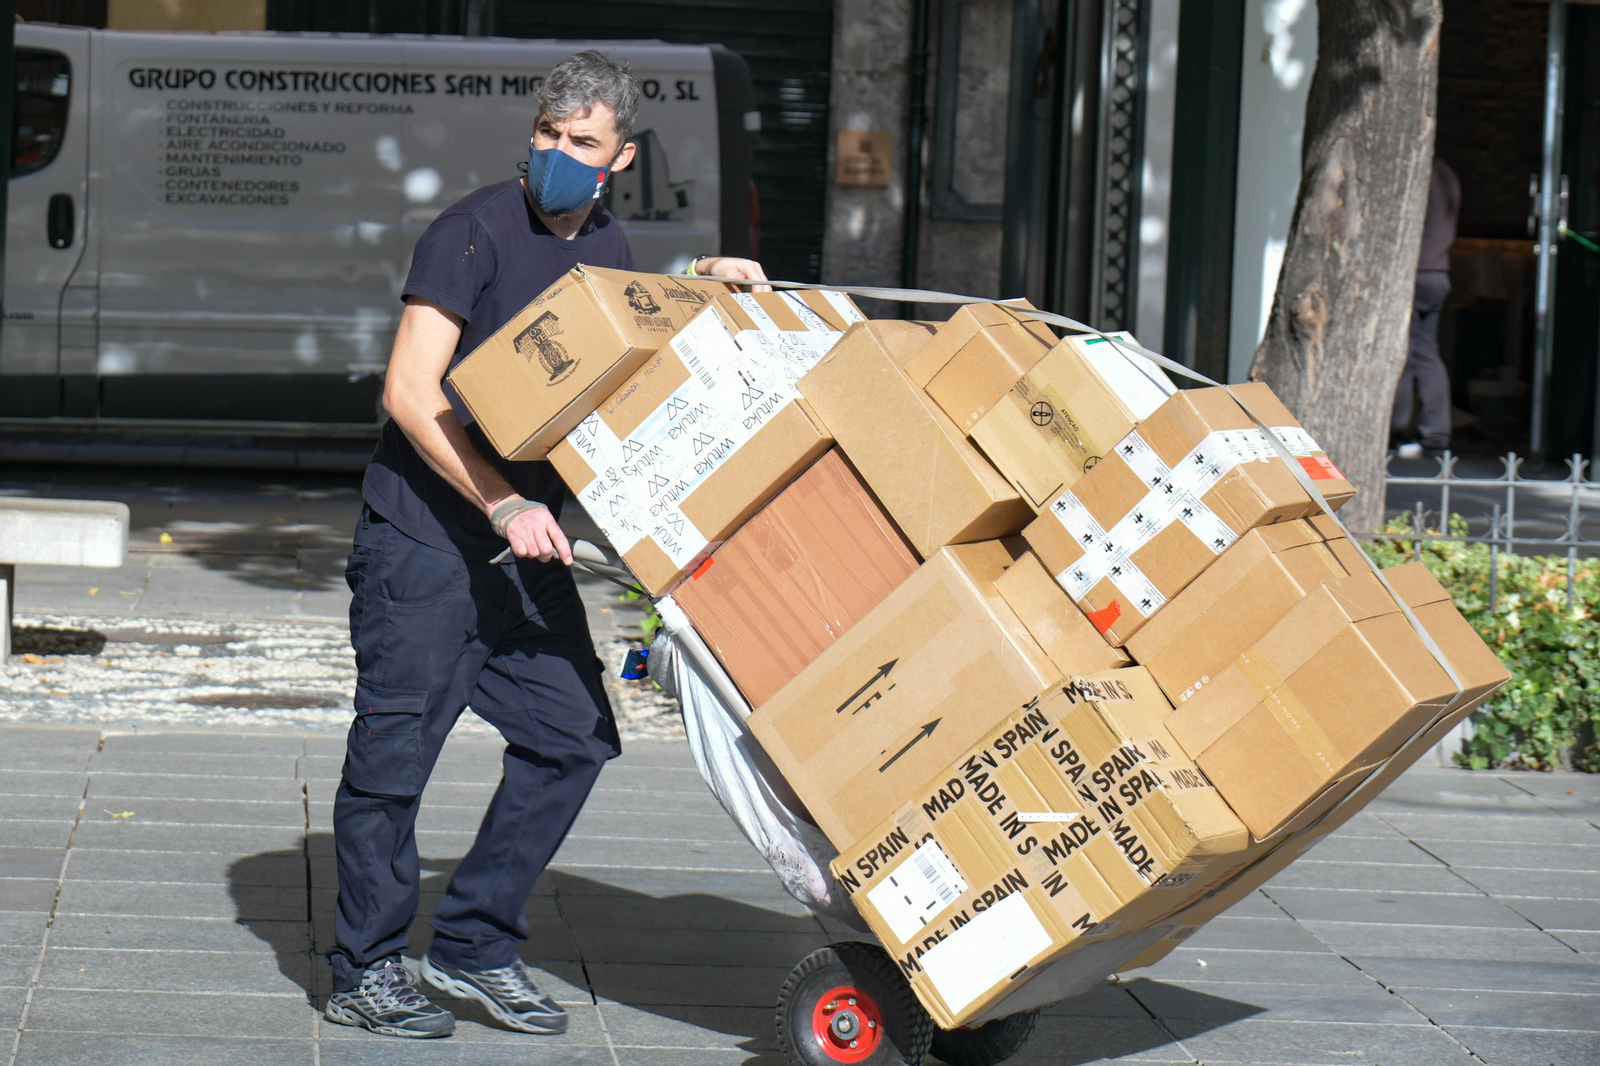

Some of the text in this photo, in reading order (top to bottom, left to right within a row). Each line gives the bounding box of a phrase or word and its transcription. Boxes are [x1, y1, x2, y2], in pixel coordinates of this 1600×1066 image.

[129, 67, 217, 91] GRUPO
[225, 69, 437, 95] CONSTRUCCIONES
[445, 74, 492, 96] SAN
[501, 75, 545, 96] MIG
[675, 79, 700, 101] SL
[165, 100, 318, 113] CONSTRUCCIONES
[321, 102, 331, 113] Y
[166, 126, 285, 138] ELECTRICIDAD
[166, 139, 346, 153] AIRE ACONDICIONADO
[165, 166, 221, 178] GRUAS
[166, 153, 303, 166] MANTENIMIENTO
[164, 192, 289, 206] EXCAVACIONES
[165, 179, 299, 193] CONTENEDORES
[741, 291, 767, 321] ituka
[667, 402, 710, 440] wituka
[742, 392, 784, 430] wituka
[570, 427, 595, 458] witu
[694, 437, 735, 475] wituka
[628, 445, 662, 477] wituk
[649, 479, 690, 517] wituka
[652, 525, 683, 556] wituk
[1281, 706, 1302, 731] HOME
[1050, 737, 1090, 787] SPA
[1148, 739, 1171, 760] MA
[1315, 751, 1335, 774] ZARA
[856, 826, 910, 878] SPAIN
[922, 778, 965, 821] MAD
[995, 707, 1049, 759] SPAIN
[1169, 768, 1205, 790] MADE
[959, 755, 1002, 816] MADE
[1000, 810, 1026, 840] IN
[1042, 814, 1100, 866] MADE
[1101, 796, 1124, 824] IN
[1119, 769, 1164, 807] SPA
[1110, 818, 1155, 878] MADE
